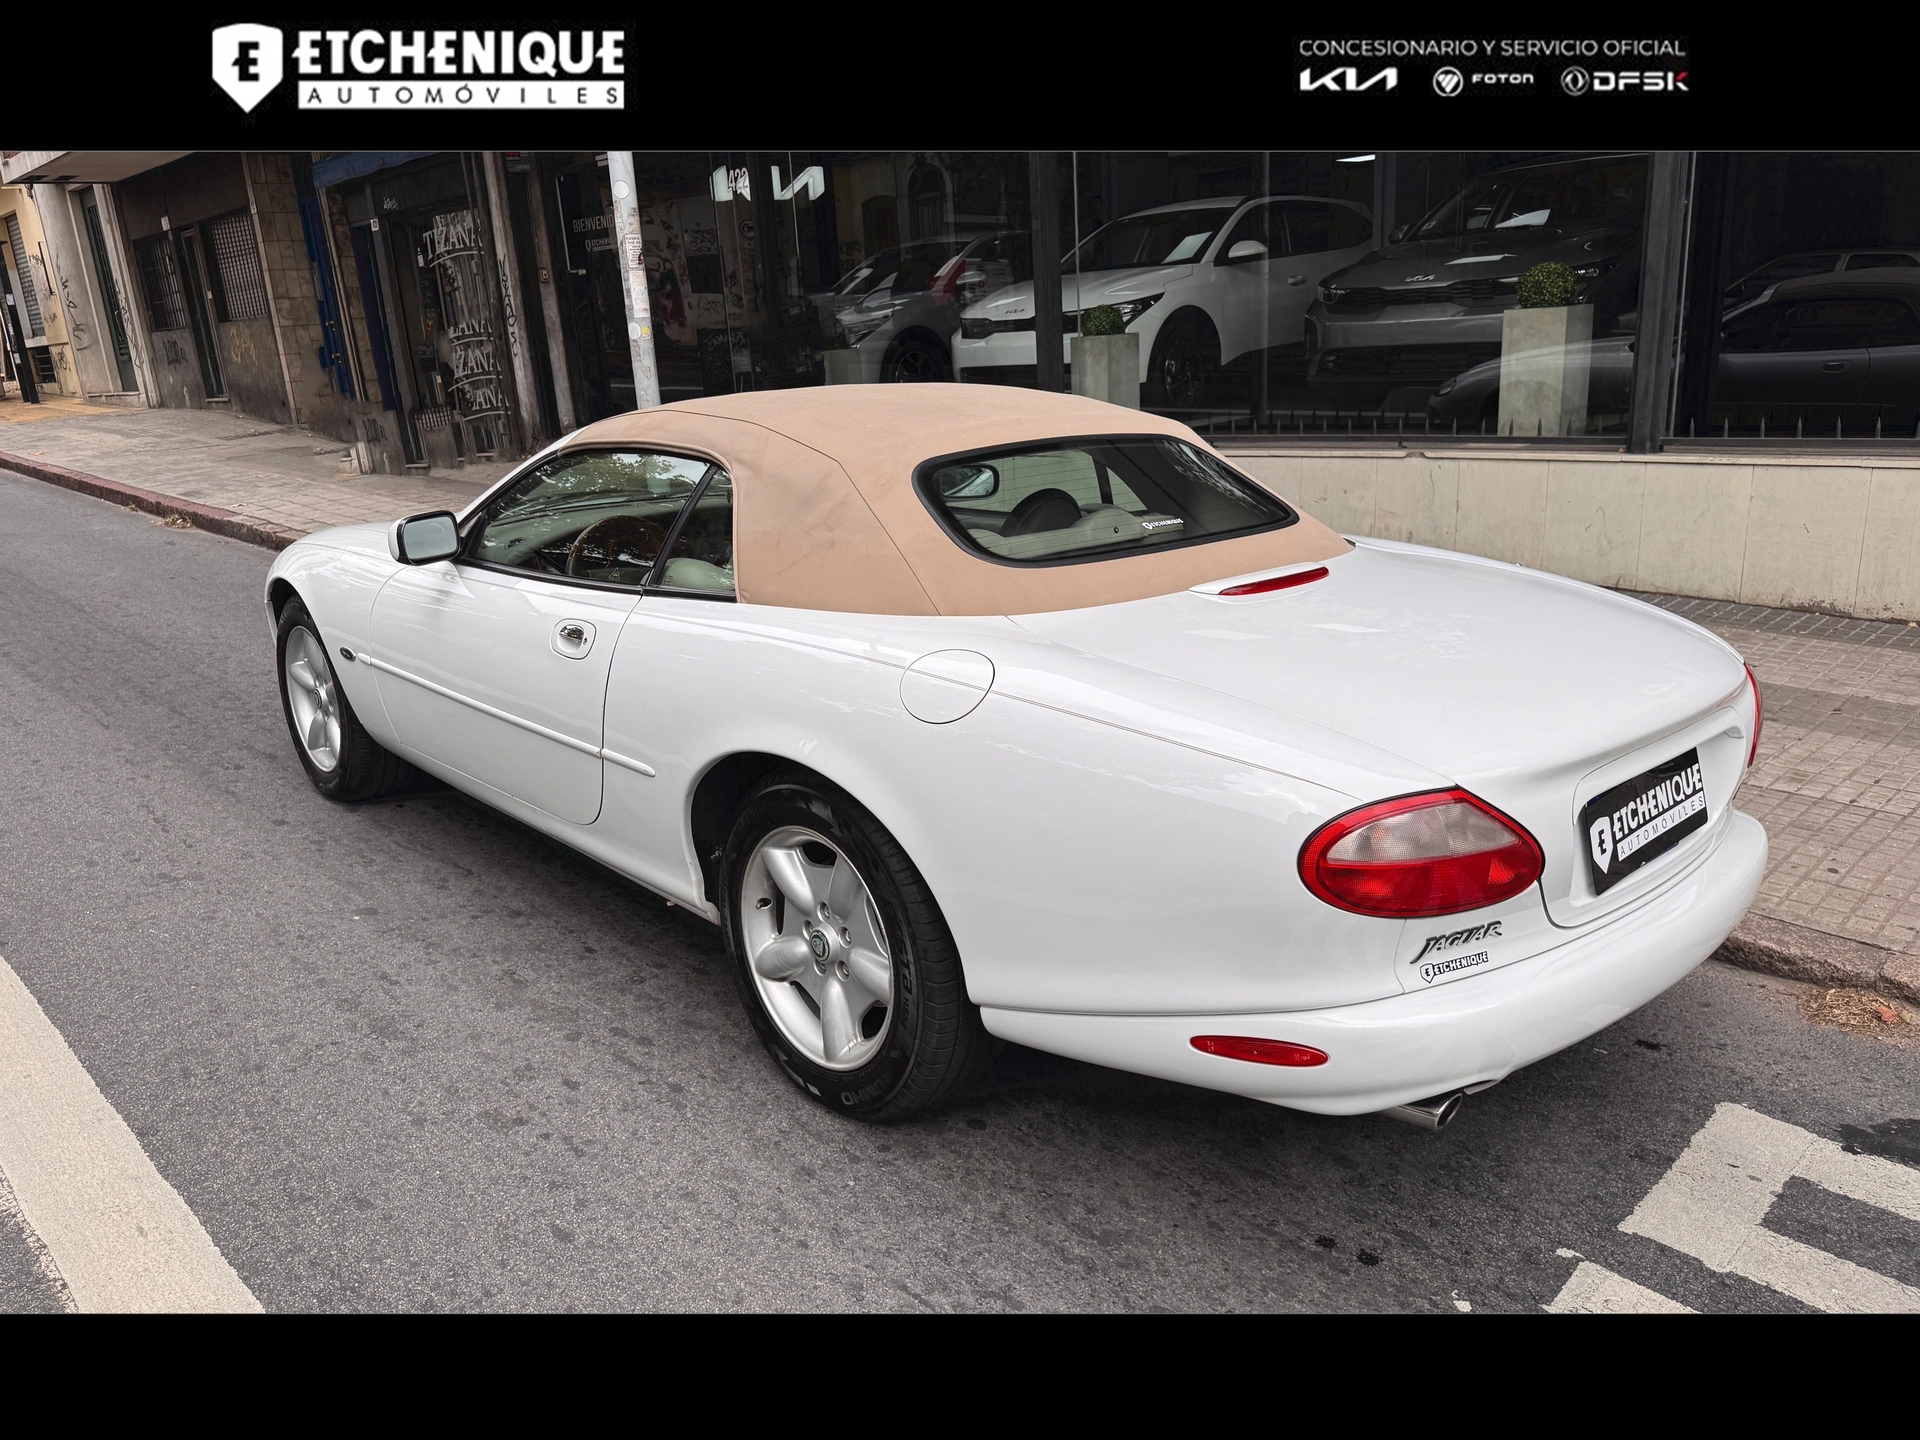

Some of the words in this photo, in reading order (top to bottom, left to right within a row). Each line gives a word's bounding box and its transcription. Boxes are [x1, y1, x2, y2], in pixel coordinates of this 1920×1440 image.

[572, 214, 616, 234] BIENVENID
[1612, 762, 1703, 841] ETCHENIQUE
[1620, 795, 1704, 858] AUTOMÓVILES
[1410, 920, 1503, 964] JAGUAR
[1433, 951, 1489, 976] ETCHENIQUE
